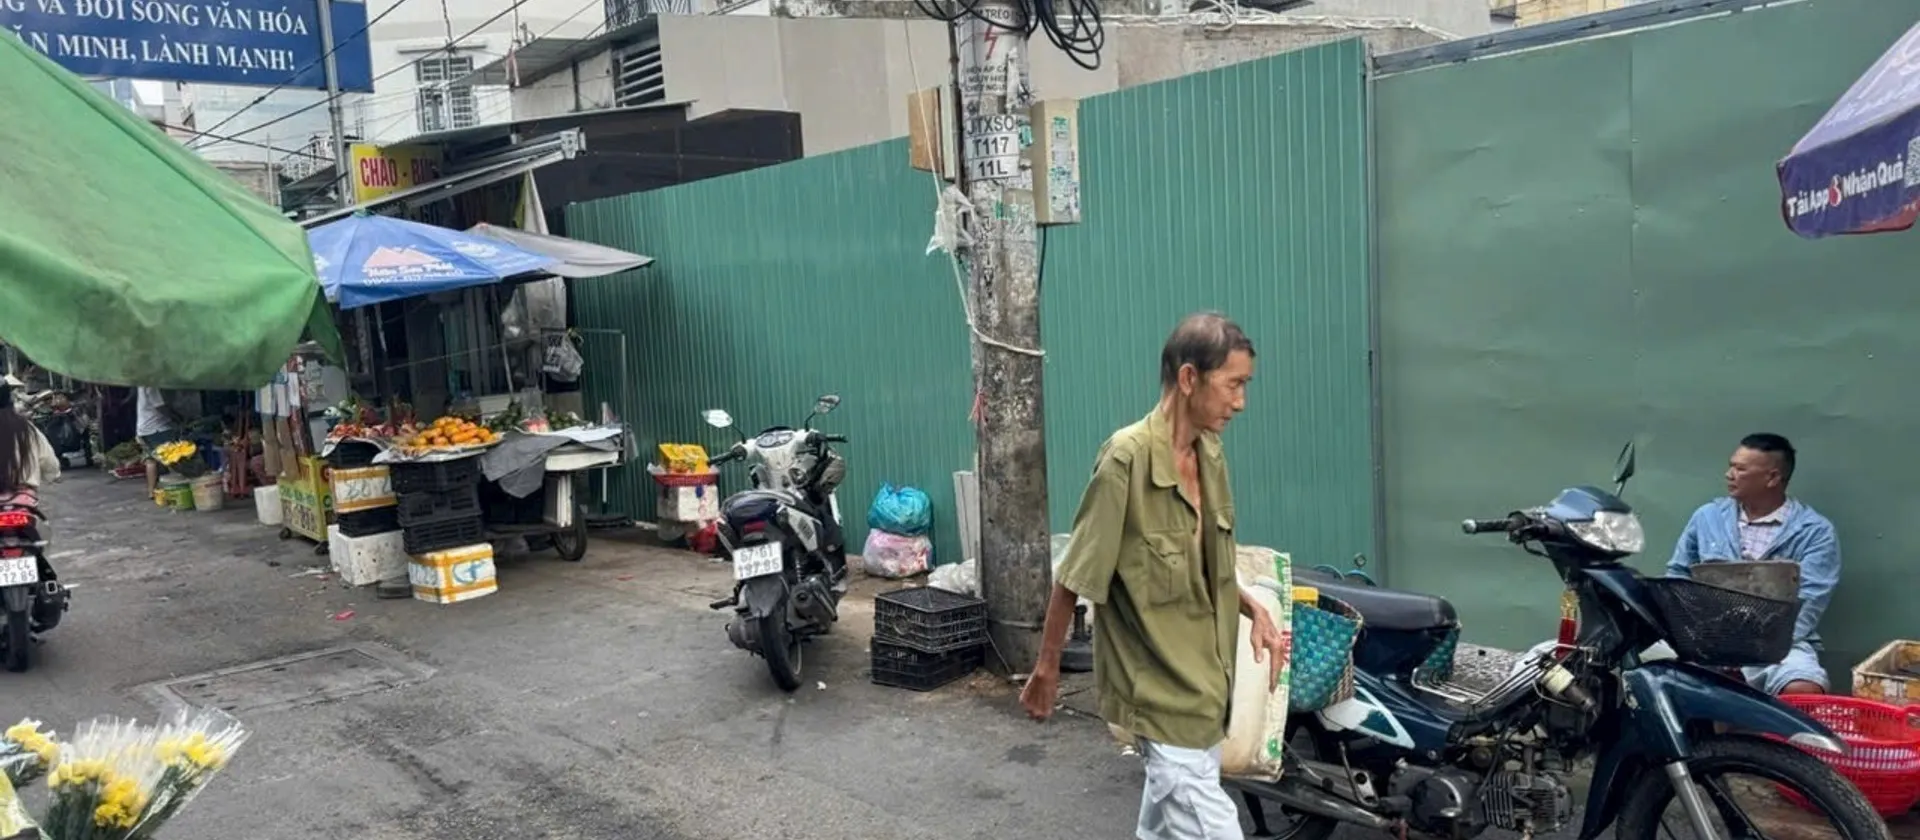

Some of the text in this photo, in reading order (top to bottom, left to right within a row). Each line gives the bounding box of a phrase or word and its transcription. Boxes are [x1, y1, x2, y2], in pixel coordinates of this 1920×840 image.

[206, 2, 252, 31] VĂN
[259, 6, 309, 36] HÓA
[57, 33, 138, 62] MINH,
[142, 34, 210, 67] LÀNH
[216, 47, 296, 75] MẠNH!
[972, 136, 1009, 157] T117
[978, 159, 1008, 177] 11L
[1843, 168, 1877, 198] Nhận
